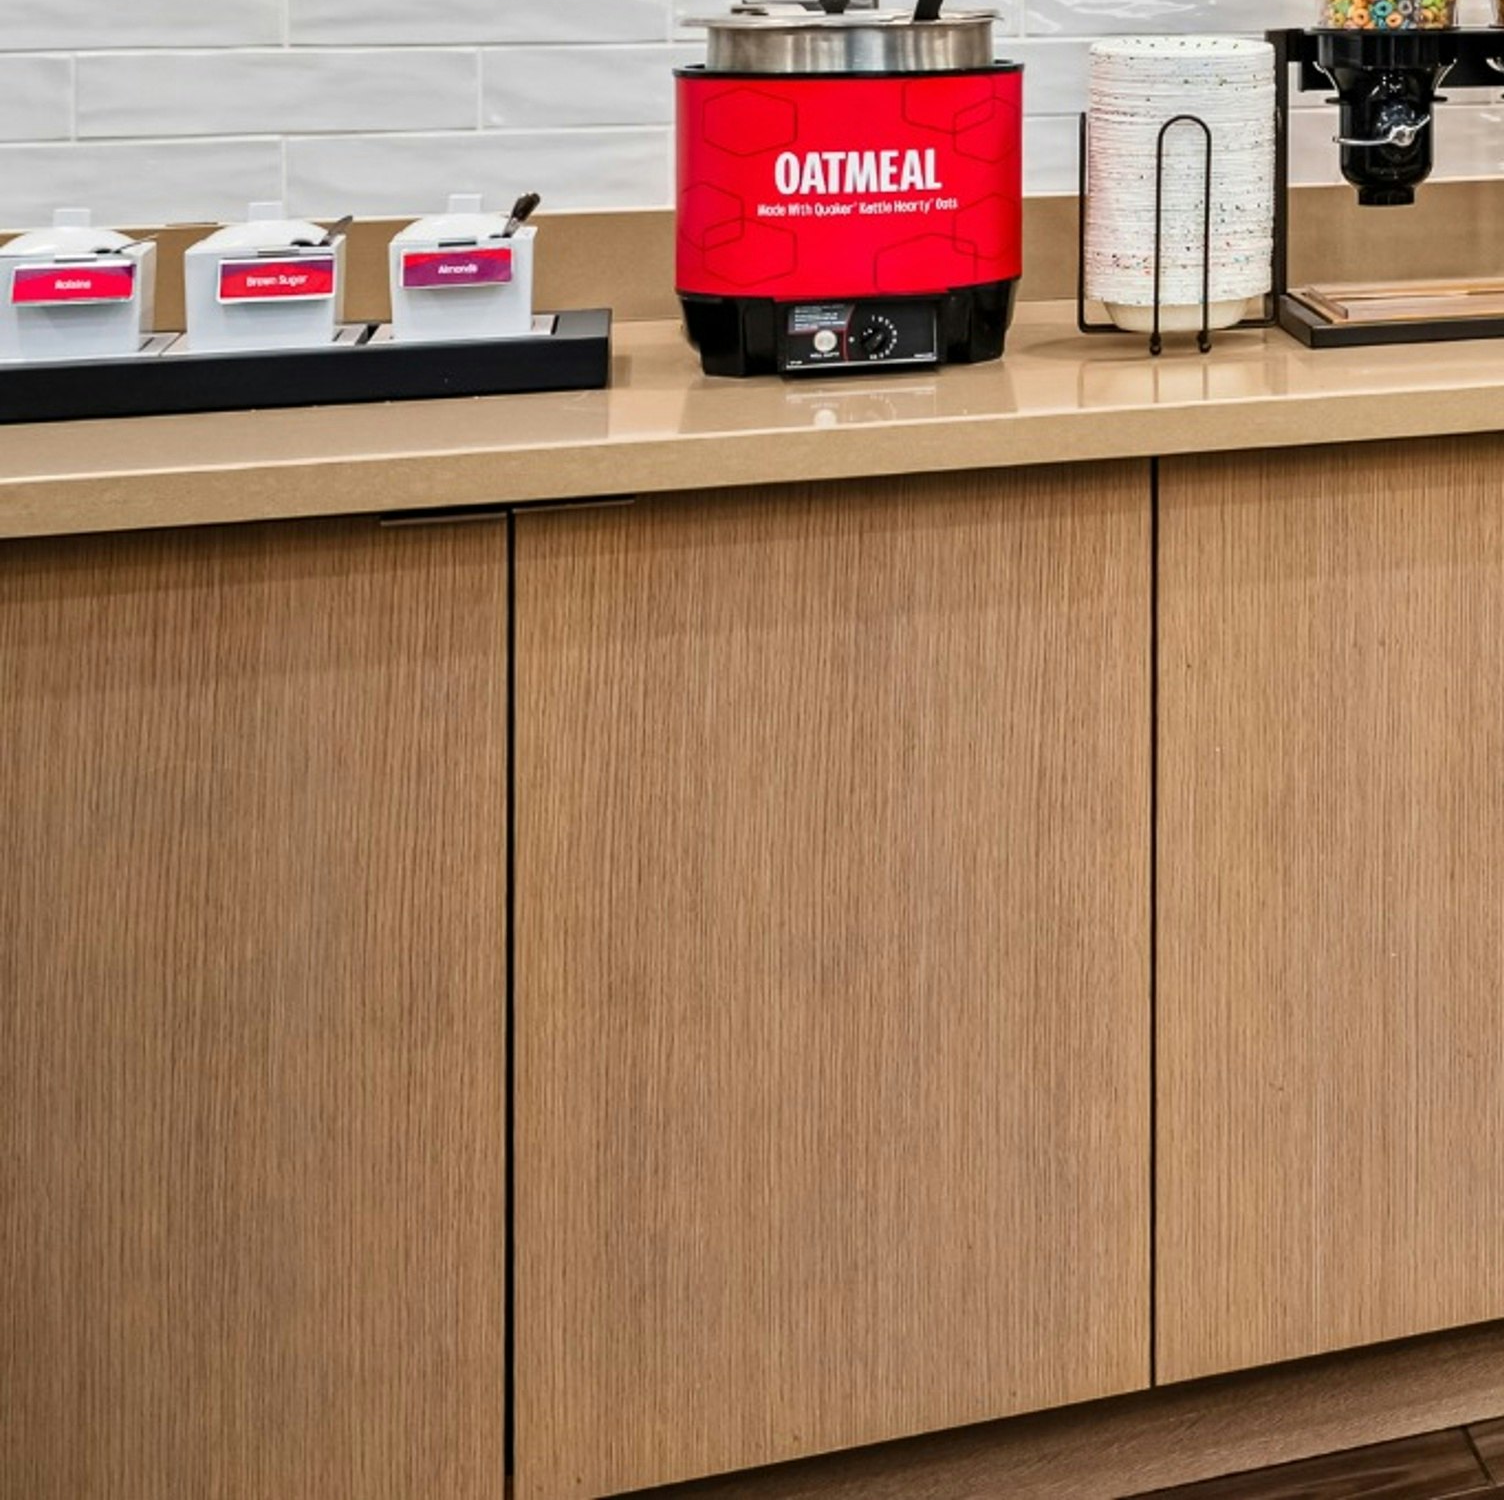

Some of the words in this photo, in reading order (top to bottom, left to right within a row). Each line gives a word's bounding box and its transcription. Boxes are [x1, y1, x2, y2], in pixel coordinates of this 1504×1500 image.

[774, 148, 943, 195] OATMEAL
[757, 203, 786, 217] Made
[788, 202, 813, 217] With
[859, 200, 893, 215] Kettle
[246, 276, 277, 287] Brown
[279, 274, 308, 287] Sugar
